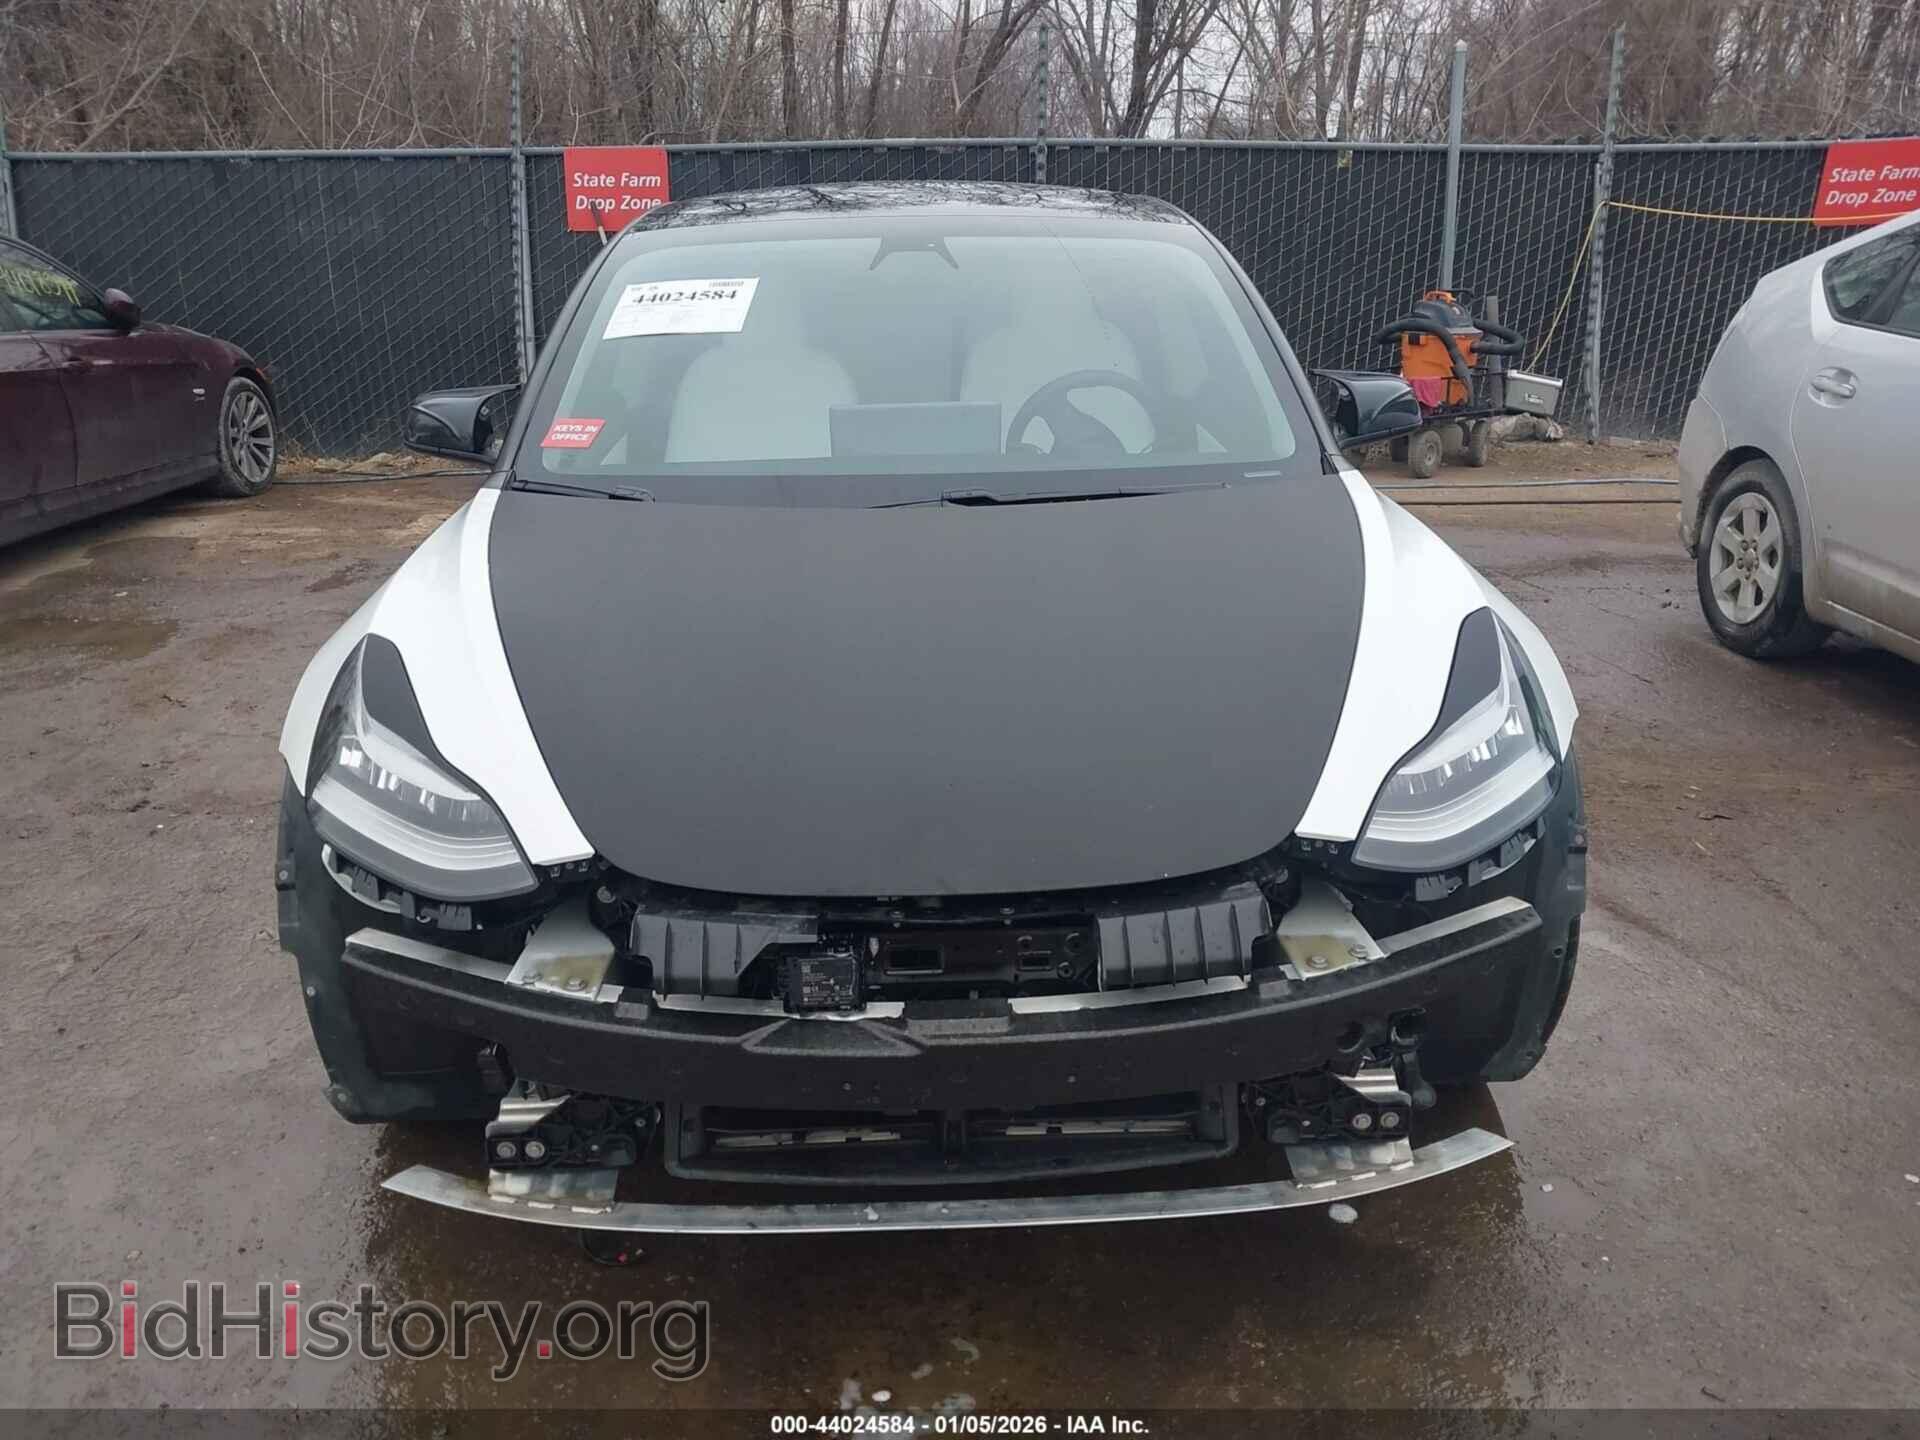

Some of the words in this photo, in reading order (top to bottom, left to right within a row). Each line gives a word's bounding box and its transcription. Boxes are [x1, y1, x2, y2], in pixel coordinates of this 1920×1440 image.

[573, 172, 616, 187] State
[620, 172, 661, 187] Farm
[1829, 167, 1876, 183] State
[1880, 165, 1920, 180] Farm
[575, 195, 616, 213] Drop
[620, 195, 662, 210] Zone
[1825, 190, 1869, 207] Drop
[1872, 188, 1917, 203] Zone
[632, 290, 737, 303] 44024584
[553, 424, 584, 432] KEYS
[551, 432, 589, 441] OFFICE
